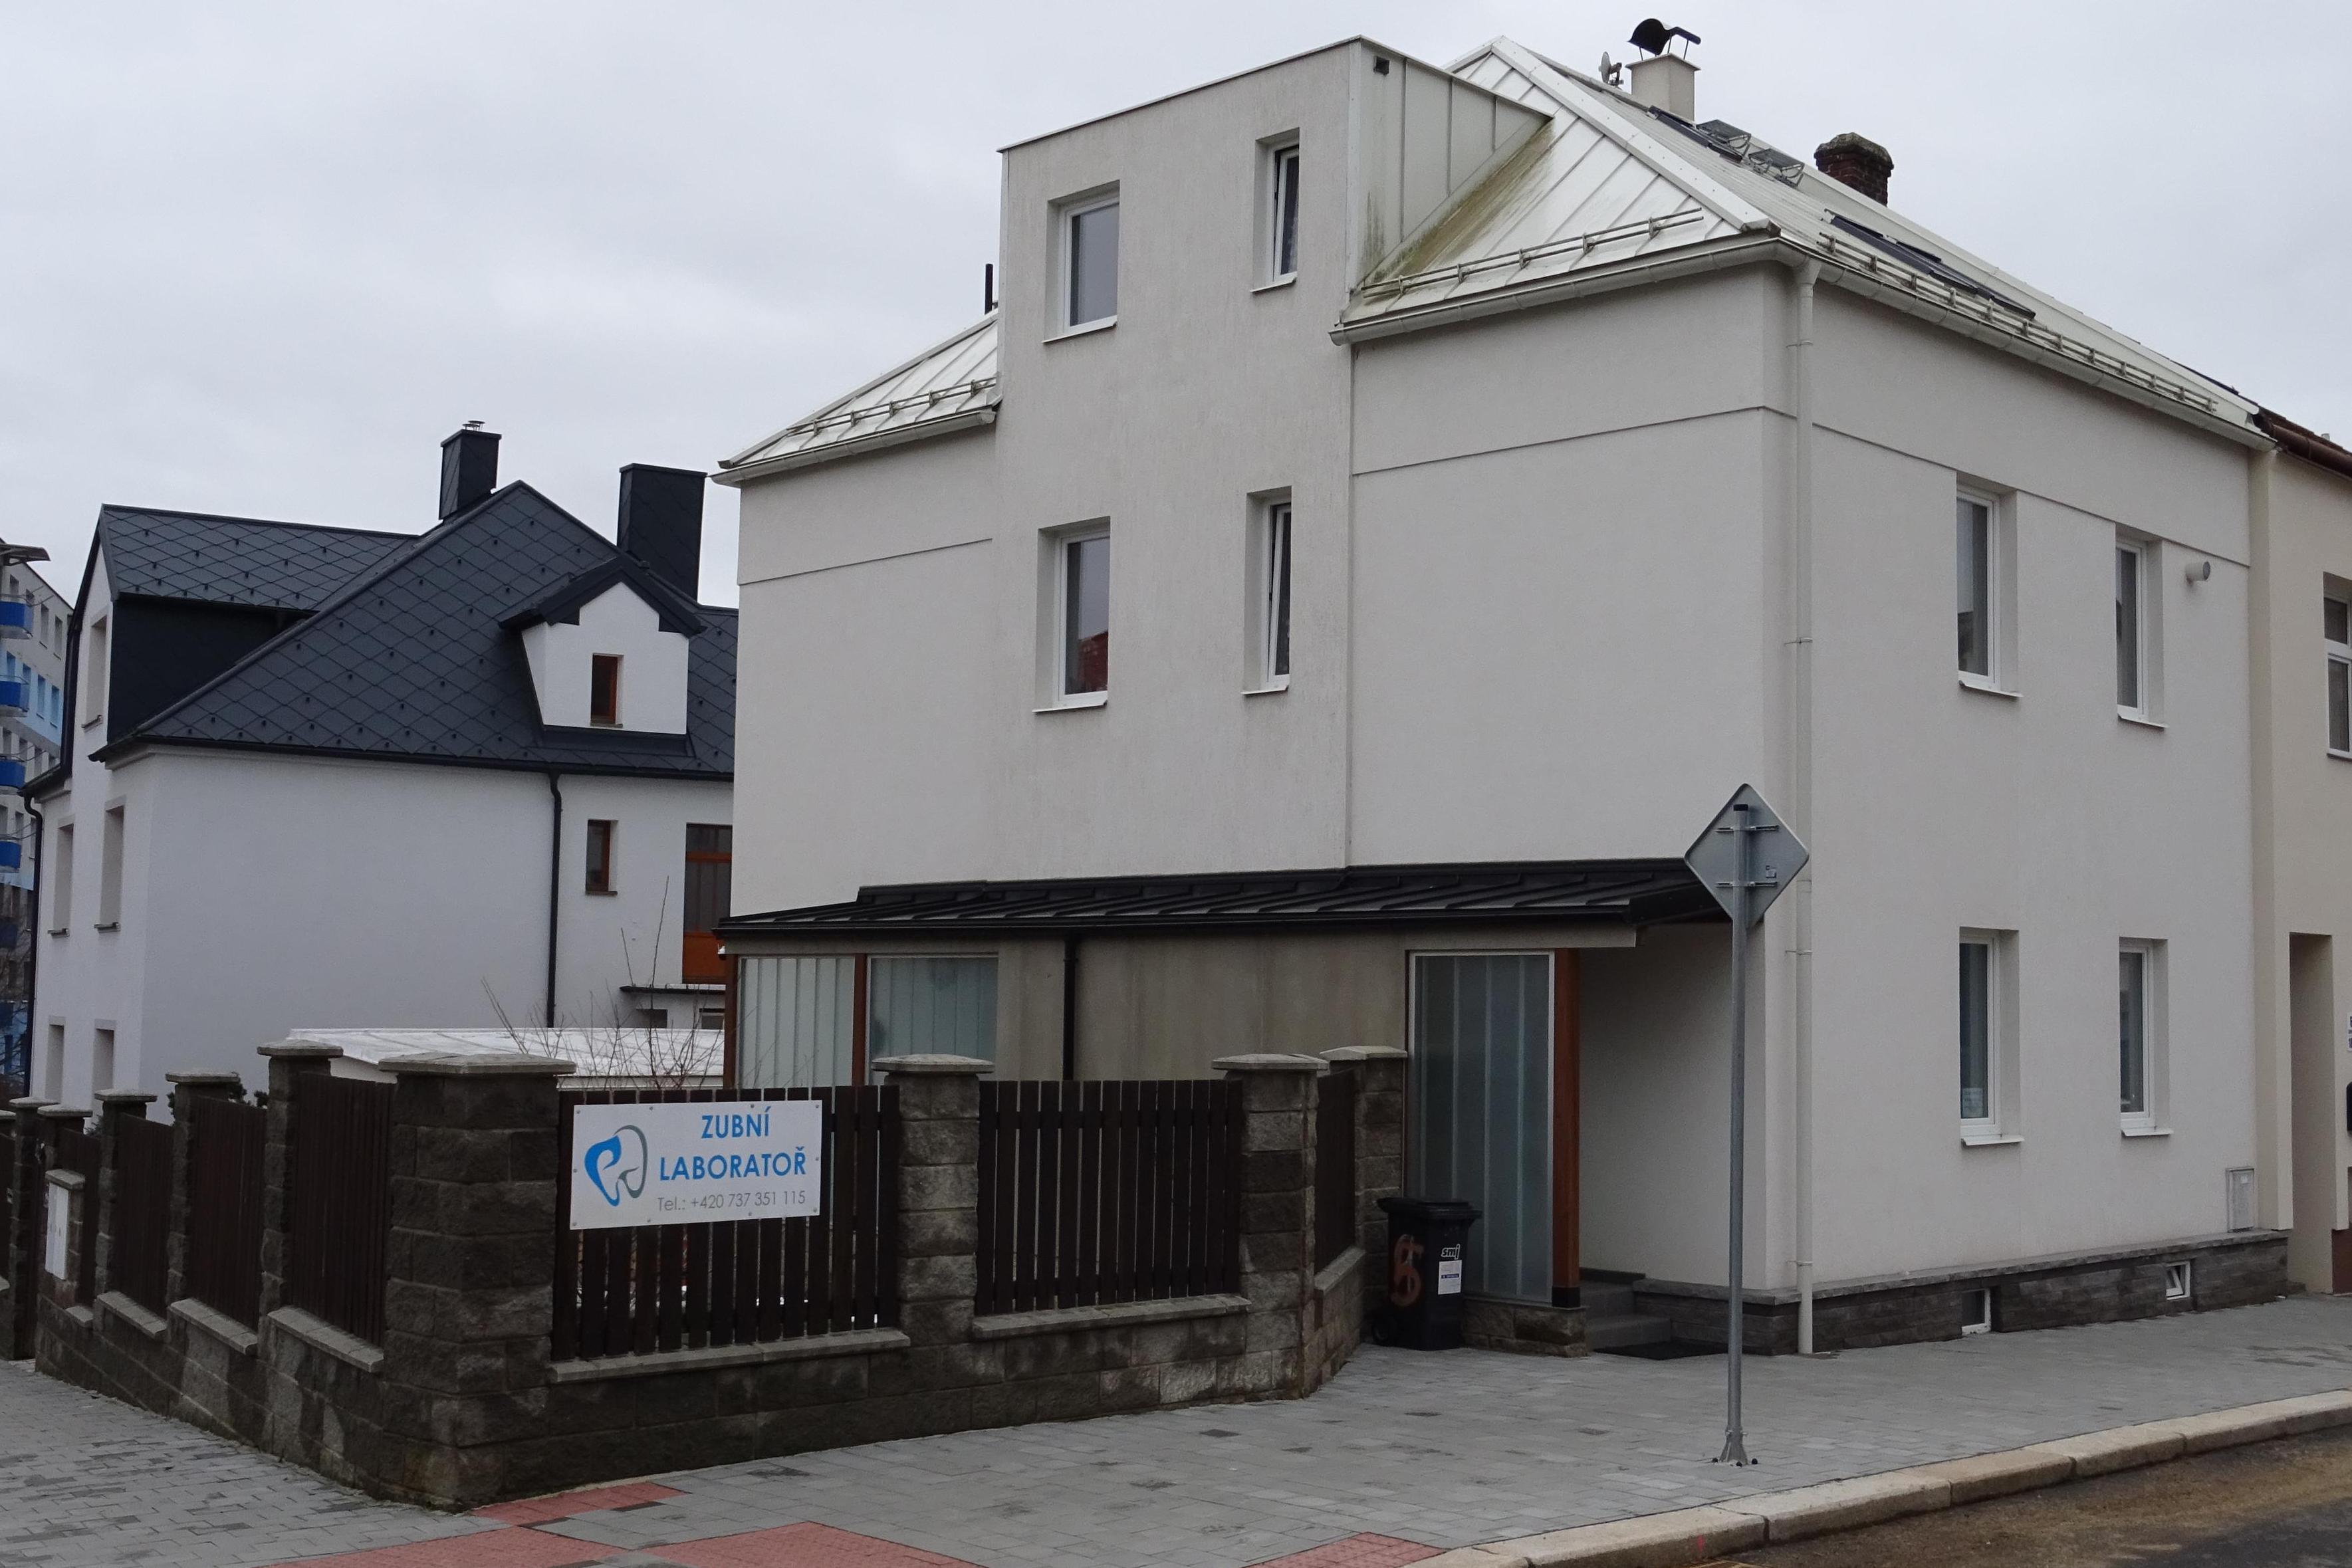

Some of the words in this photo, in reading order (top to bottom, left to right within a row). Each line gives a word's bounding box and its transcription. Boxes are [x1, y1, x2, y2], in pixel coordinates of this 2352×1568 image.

[701, 1106, 772, 1139] ZUBNÍ
[659, 1146, 806, 1181] LABORATOŘ
[657, 1197, 686, 1211] Tel.:
[691, 1194, 724, 1209] +420
[728, 1192, 752, 1208] 737
[755, 1191, 776, 1206] 351
[783, 1190, 806, 1205] 115
